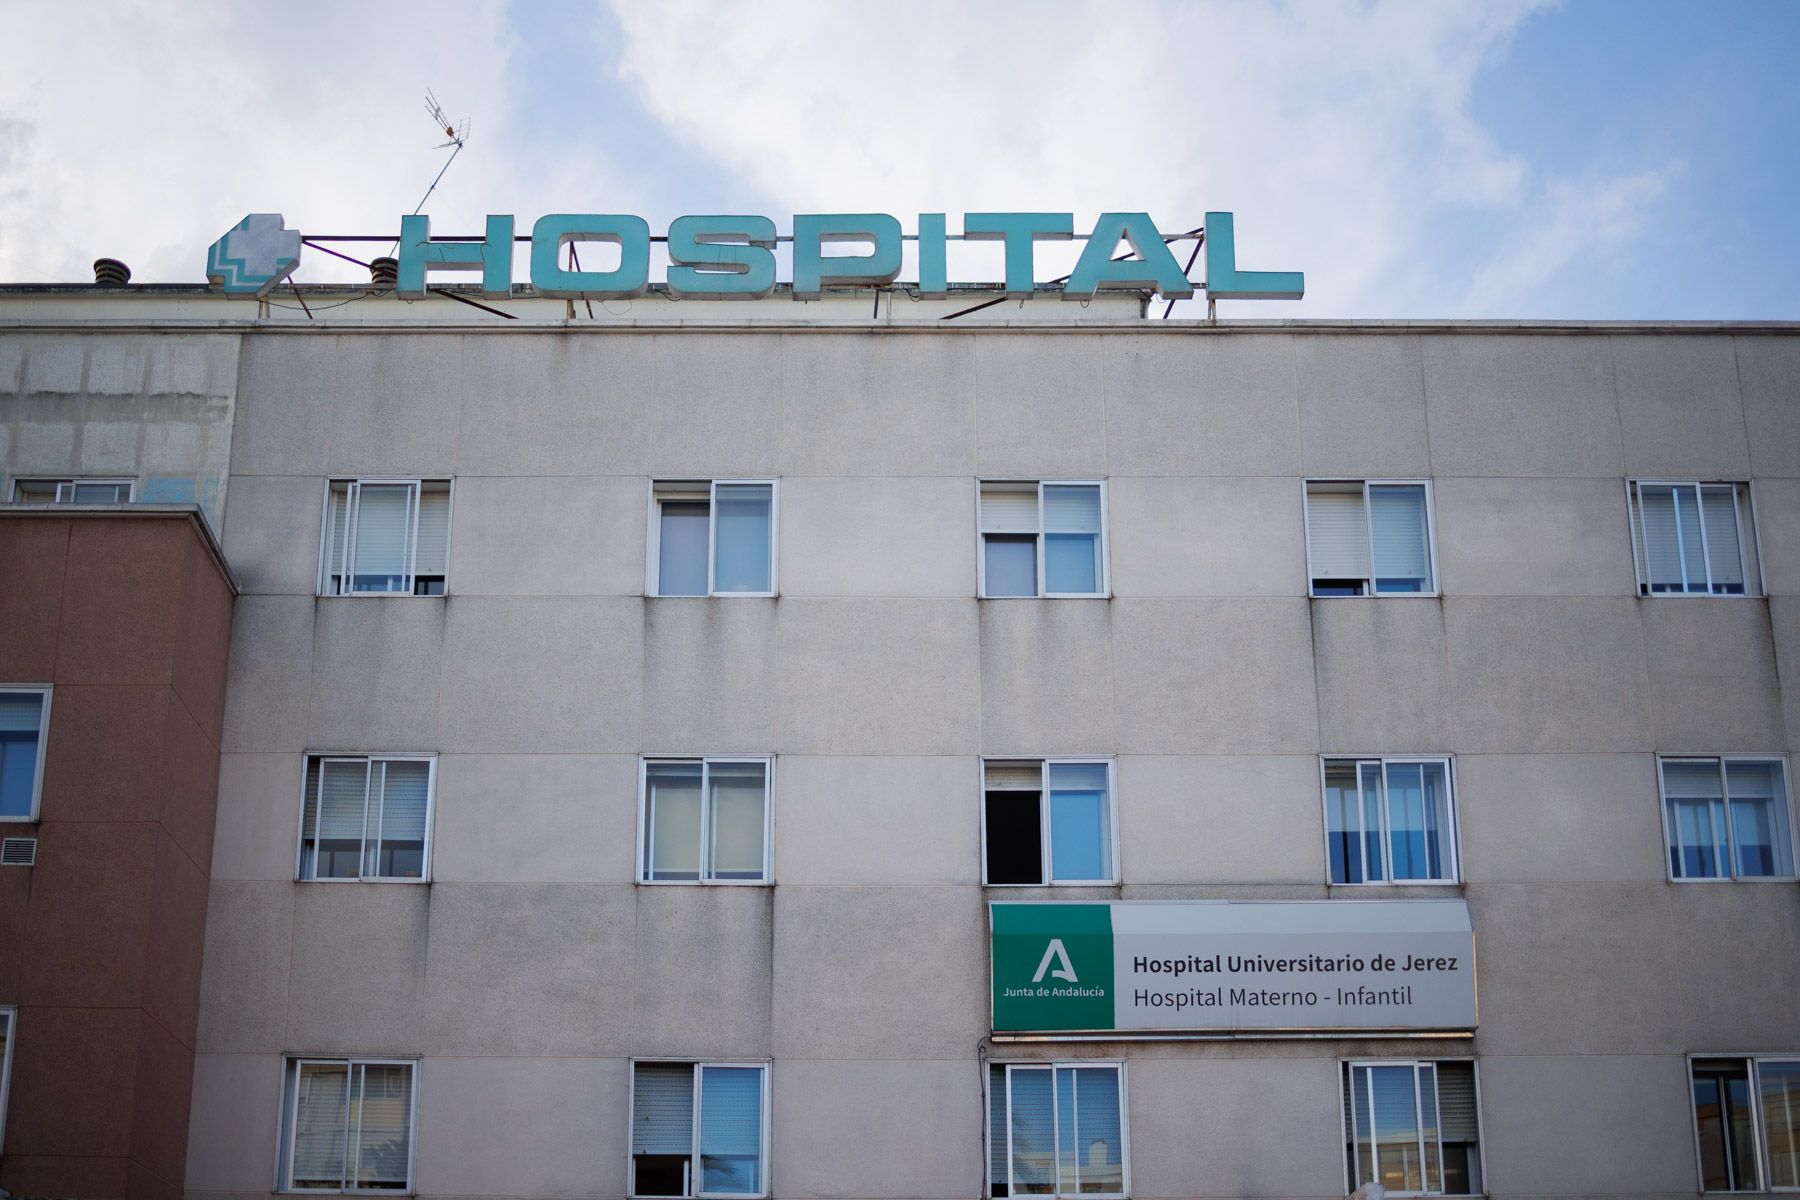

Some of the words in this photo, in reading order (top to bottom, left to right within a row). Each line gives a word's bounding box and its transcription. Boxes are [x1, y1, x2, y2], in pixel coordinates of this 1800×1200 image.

[397, 211, 1305, 300] HOSPITAL
[1133, 954, 1222, 977] Hospital
[1227, 953, 1365, 974] Universitario
[1370, 953, 1396, 973] de
[1401, 953, 1458, 972] Jerez
[1003, 986, 1034, 998] Junta
[1036, 986, 1050, 998] de
[1051, 985, 1105, 998] Andalucía
[1133, 987, 1223, 1011] Hospital
[1229, 987, 1318, 1007] Materno
[1337, 985, 1413, 1006] Infantil
